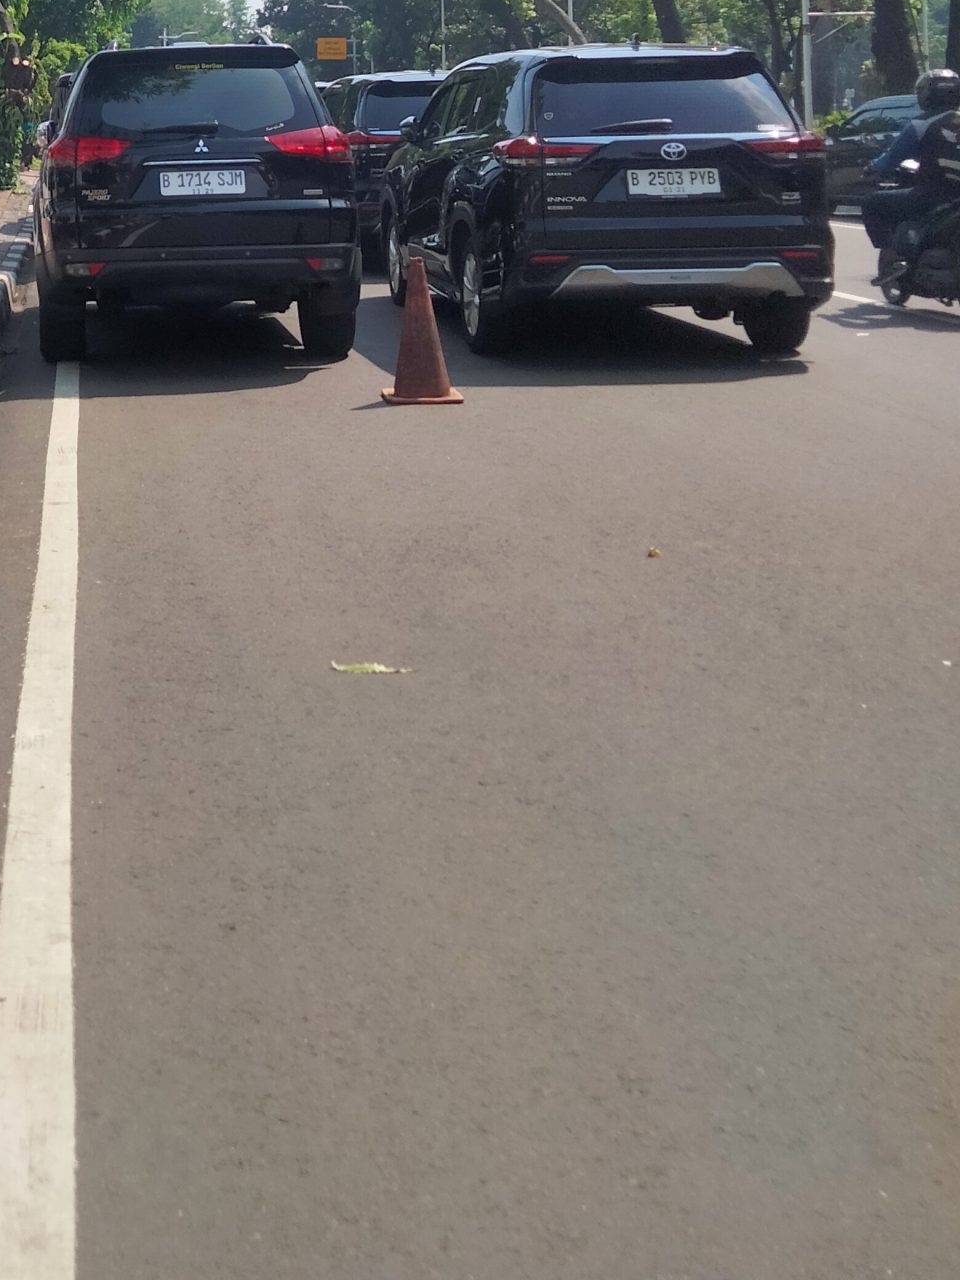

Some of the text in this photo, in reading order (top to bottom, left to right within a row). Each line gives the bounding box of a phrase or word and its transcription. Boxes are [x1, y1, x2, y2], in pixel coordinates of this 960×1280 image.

[162, 171, 243, 188] B 1714 SJM
[631, 170, 716, 186] B 2503 PYB
